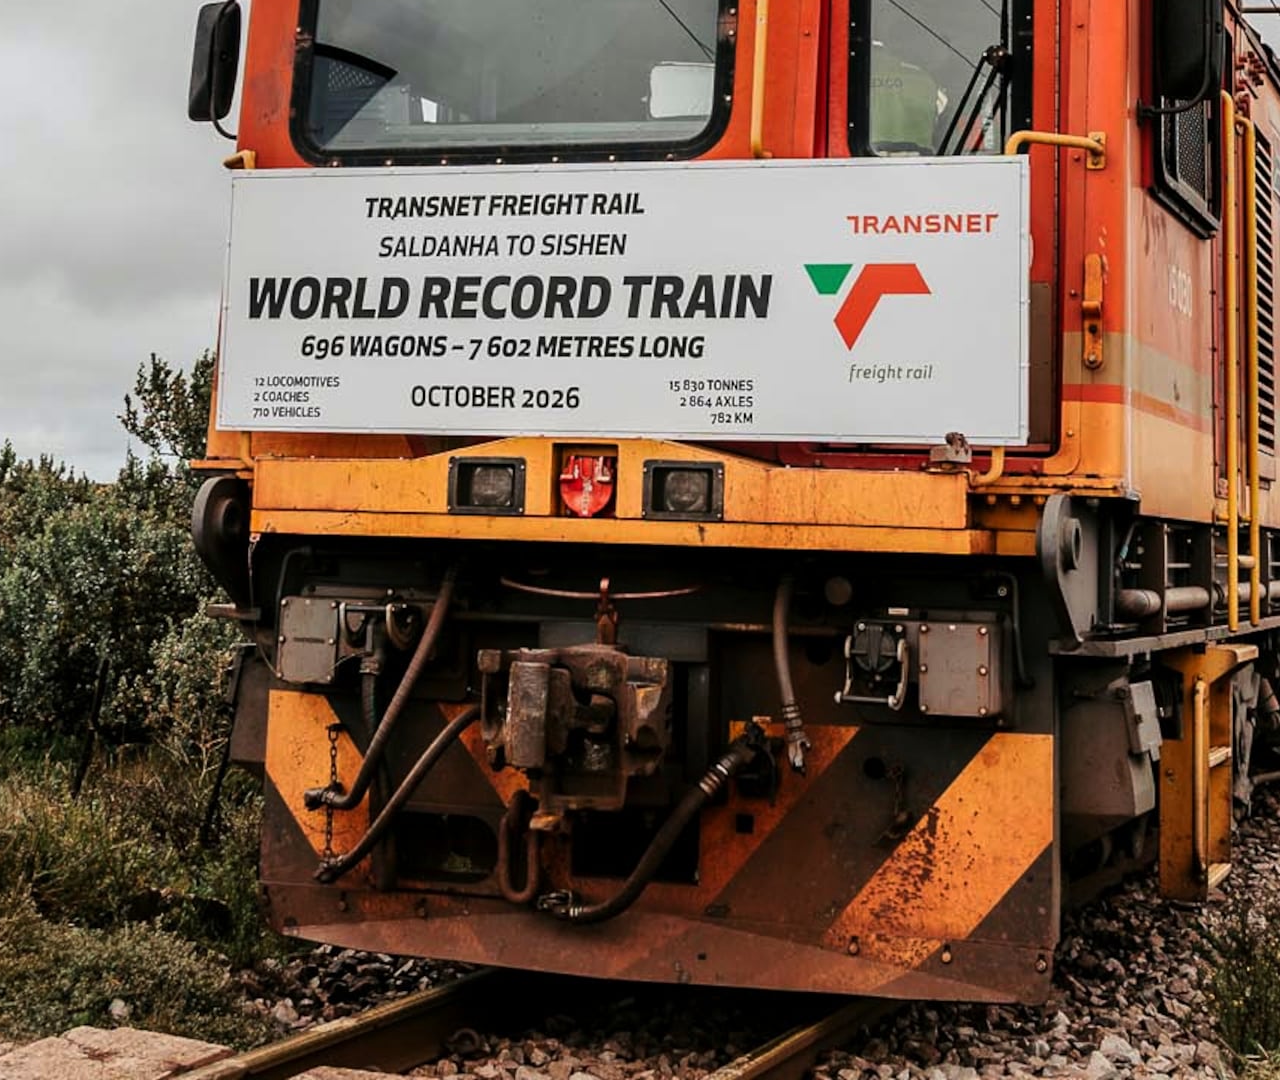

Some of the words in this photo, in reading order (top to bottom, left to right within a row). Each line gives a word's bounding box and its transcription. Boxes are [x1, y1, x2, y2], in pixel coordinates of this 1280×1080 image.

[366, 196, 485, 220] TRANSNET
[489, 194, 588, 216] FREIGHT
[591, 193, 644, 214] RAIL
[847, 214, 998, 233] TRANSNET
[379, 236, 498, 257] SALDANHA
[507, 235, 535, 256] TO
[541, 234, 627, 255] SISHEN
[249, 277, 409, 319] WORLD
[419, 275, 611, 319] RECORD
[623, 275, 772, 318] TRAIN
[302, 336, 344, 360] 696
[351, 336, 447, 357] WAGONS
[469, 339, 482, 360] 7
[487, 336, 531, 357] 602
[536, 336, 634, 357] METRES
[639, 336, 704, 358] LONG
[255, 377, 265, 387] 12
[267, 376, 340, 387] LOCOMOTIVES
[849, 364, 902, 383] freight
[907, 365, 932, 379] rail
[669, 380, 681, 392] 15
[682, 379, 705, 392] 830
[707, 380, 753, 391] TONNES
[253, 392, 261, 402] 2
[262, 391, 309, 402] COACHES
[412, 386, 515, 408] OCTOBER
[522, 387, 579, 408] 2026
[679, 396, 687, 407] 2
[688, 395, 713, 408] 864
[715, 396, 753, 407] AXLES
[252, 407, 270, 418] 710
[272, 407, 320, 417] VEHICLES
[710, 411, 732, 424] 782
[734, 412, 753, 423] KM
